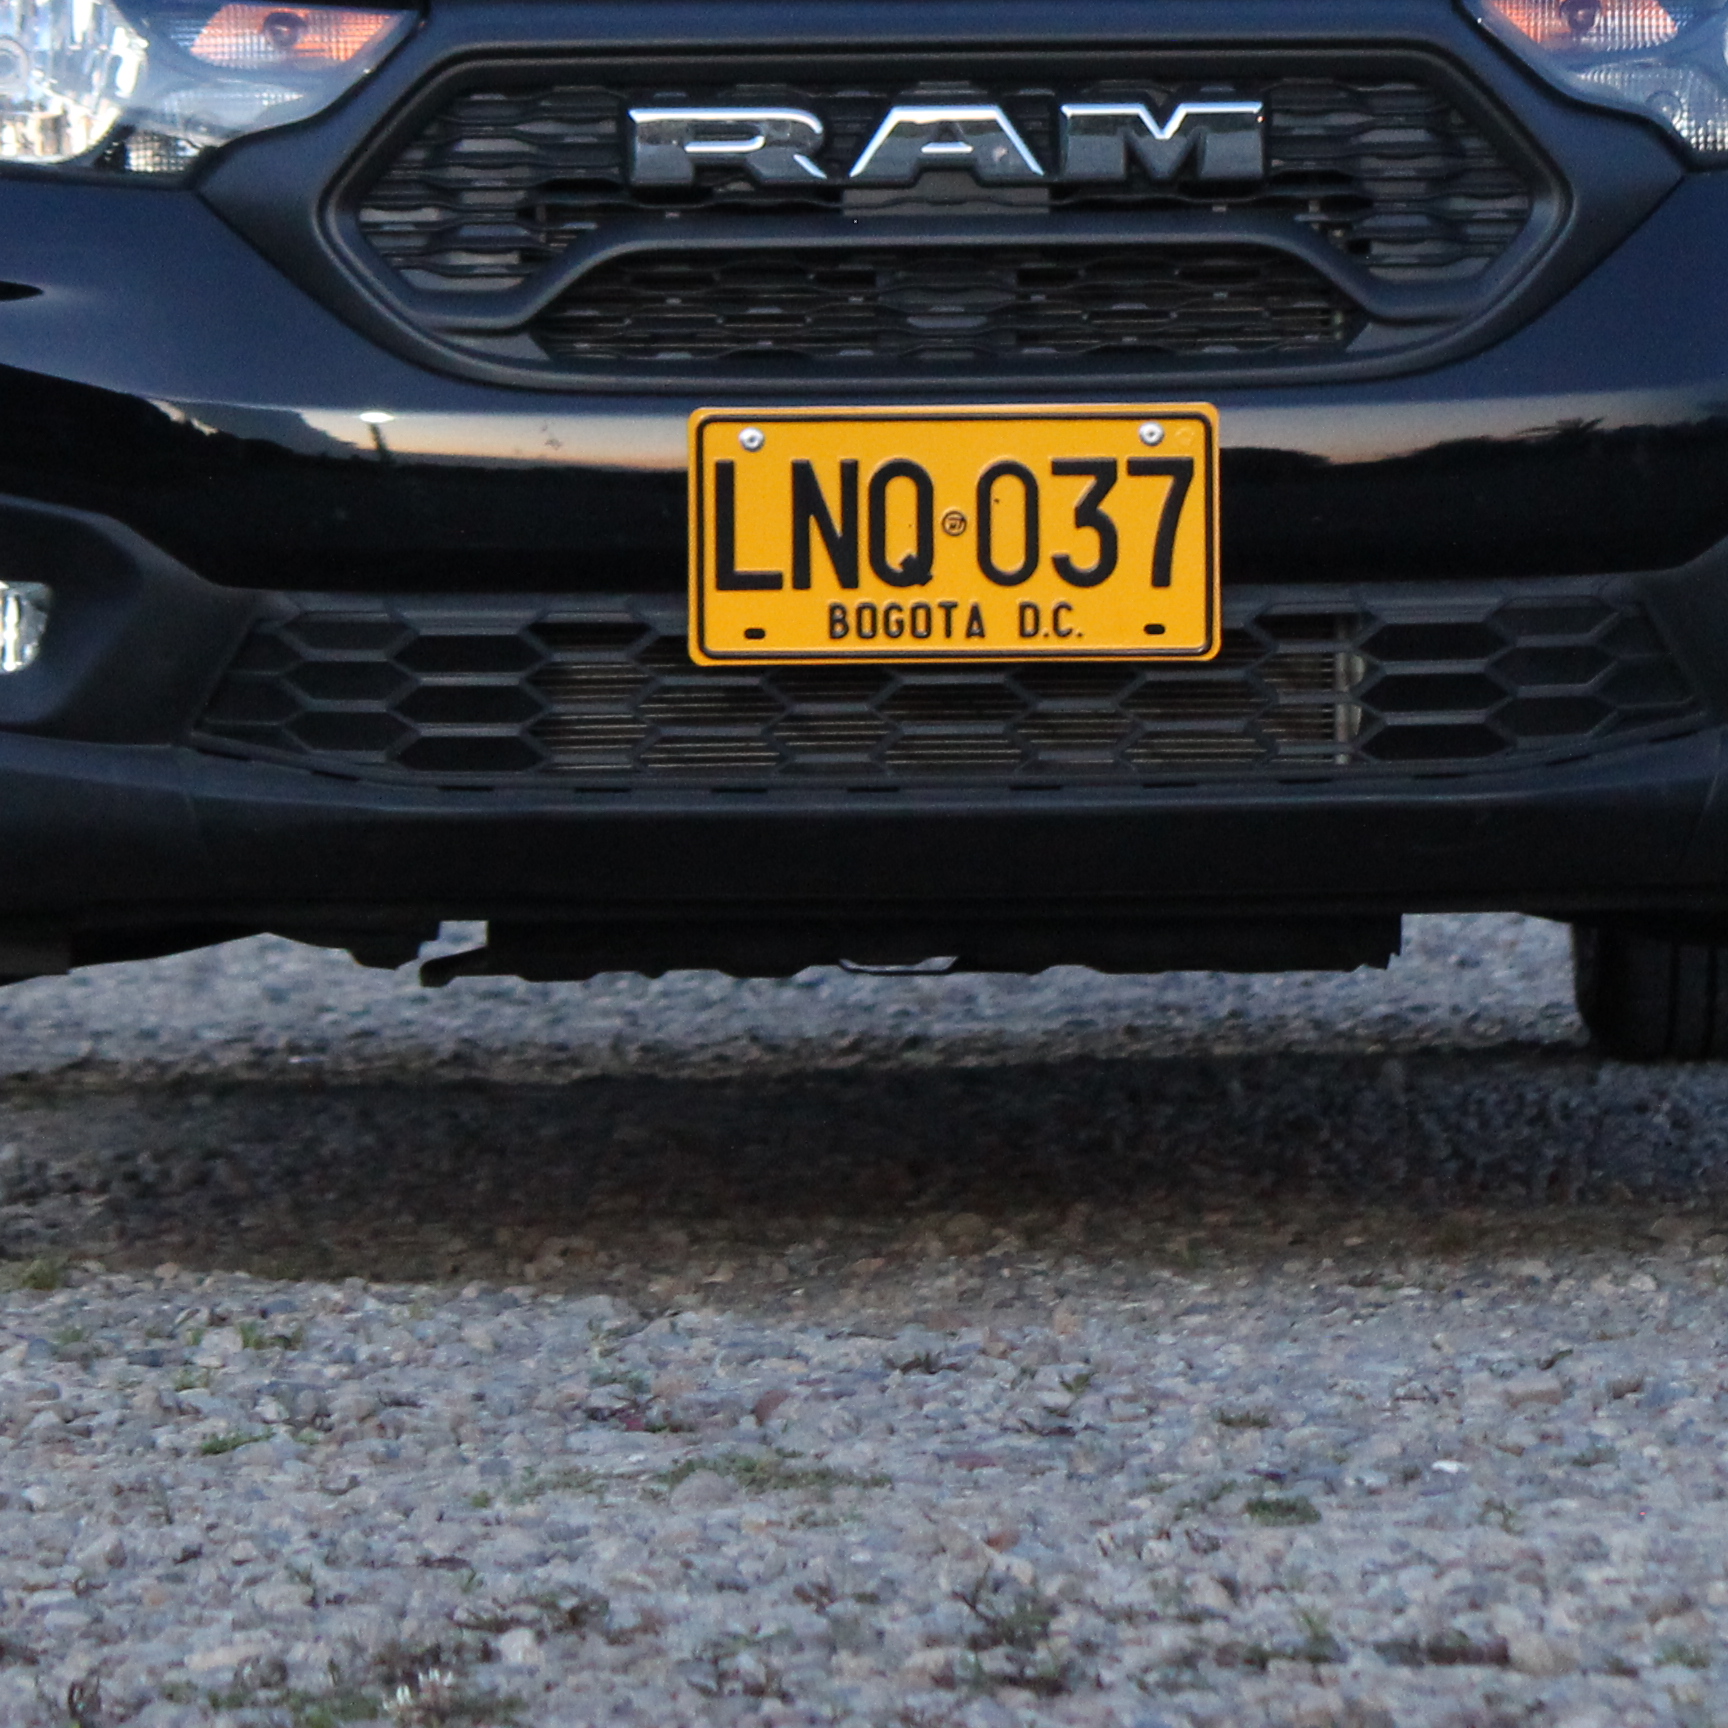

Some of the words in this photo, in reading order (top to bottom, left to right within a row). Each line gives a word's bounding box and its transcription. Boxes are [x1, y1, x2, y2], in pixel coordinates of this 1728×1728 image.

[628, 102, 1265, 181] RAM
[715, 458, 934, 590] LNQ
[976, 457, 1194, 588] 037
[828, 601, 986, 640] BOGOTA
[1018, 601, 1084, 638] D.C.
